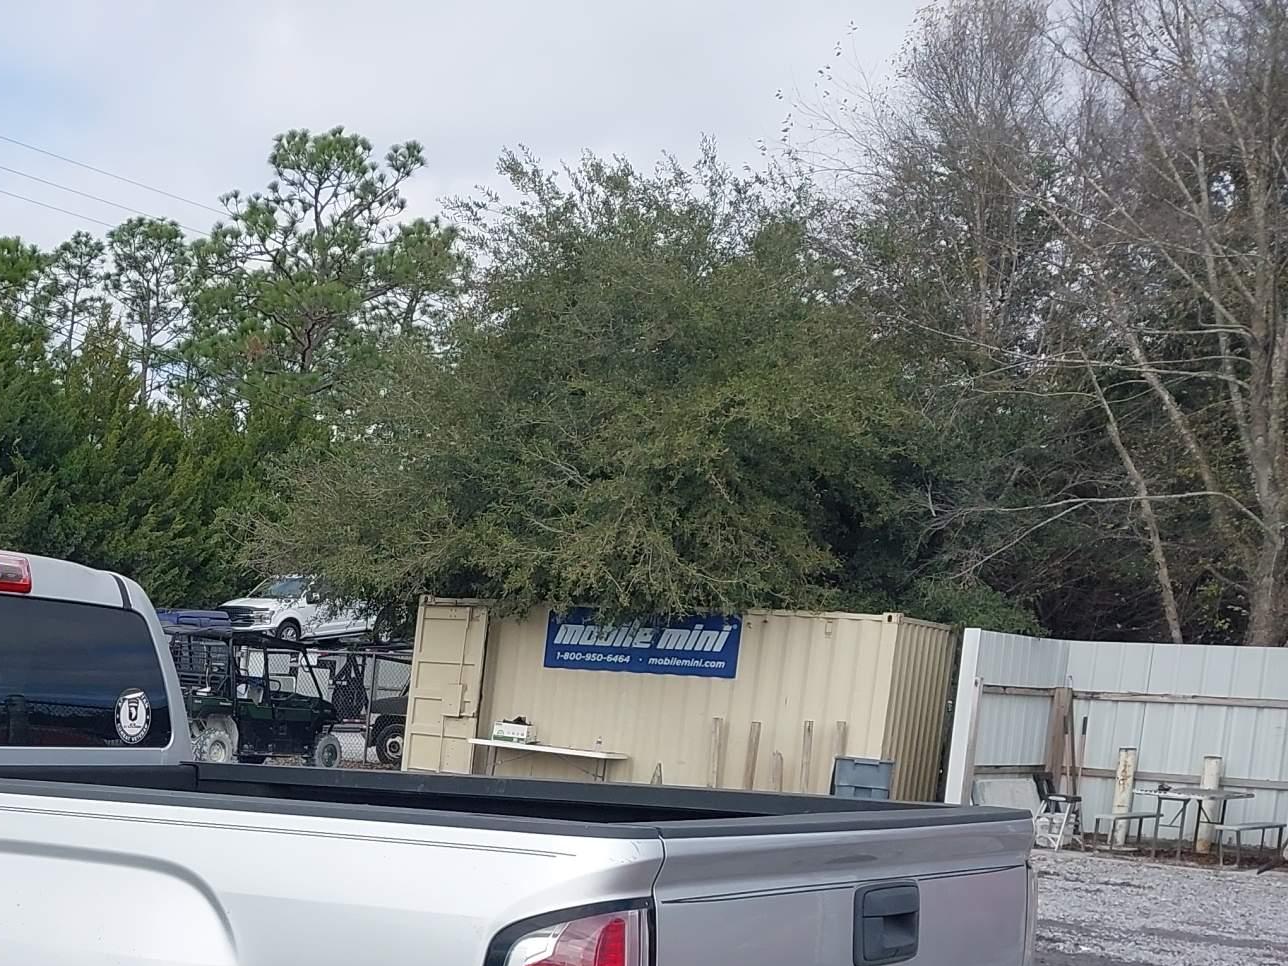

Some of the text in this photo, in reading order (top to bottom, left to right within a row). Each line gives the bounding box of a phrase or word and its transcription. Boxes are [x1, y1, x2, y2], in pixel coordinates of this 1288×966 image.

[553, 618, 733, 652] mobile mini
[556, 651, 726, 669] 1-800-950-6464 mobilemini.com
